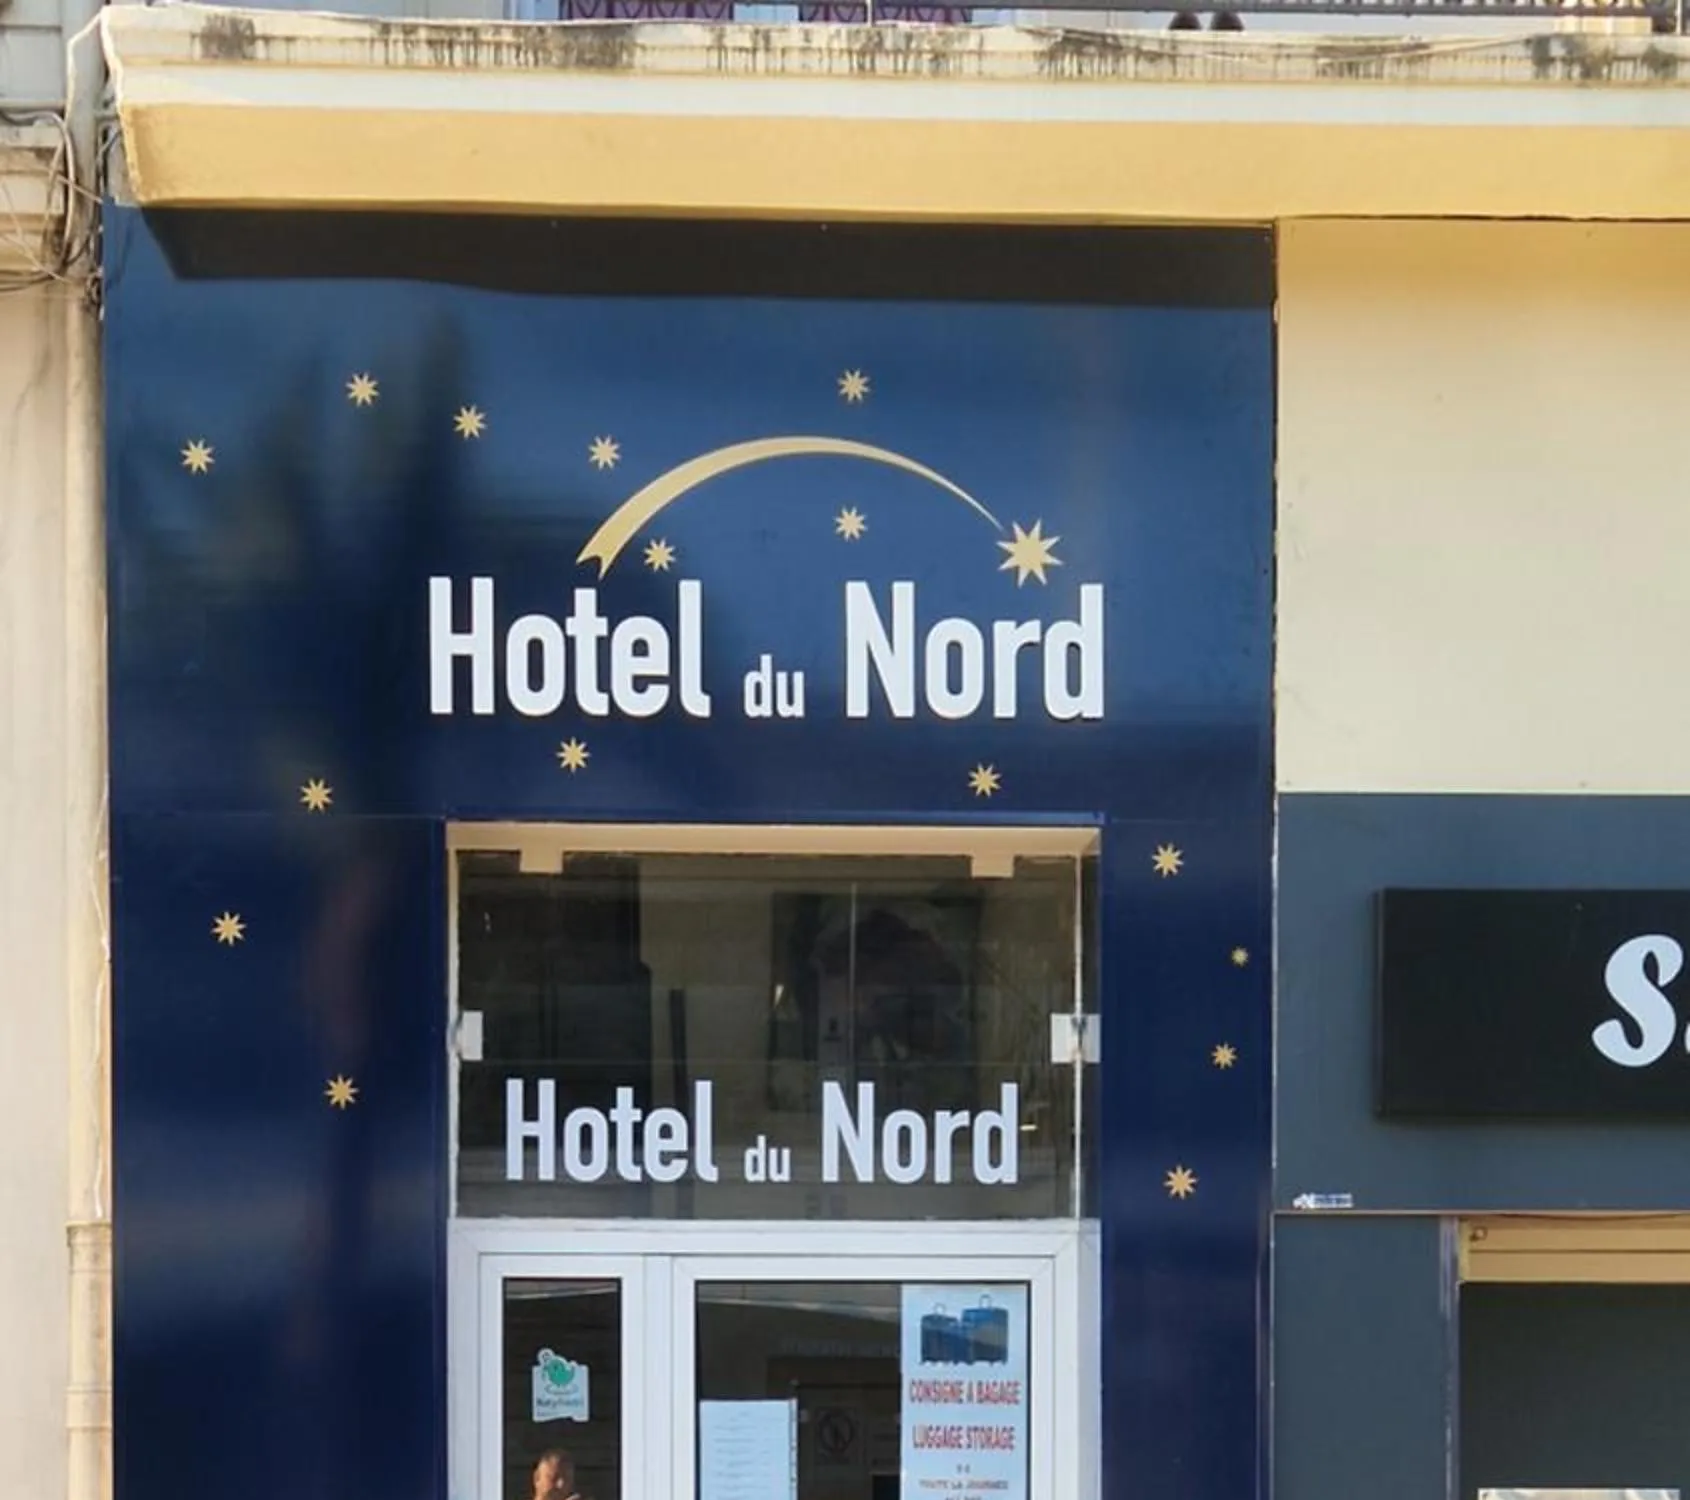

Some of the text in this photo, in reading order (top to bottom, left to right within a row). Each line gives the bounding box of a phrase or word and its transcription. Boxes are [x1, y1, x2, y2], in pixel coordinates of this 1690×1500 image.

[429, 576, 1104, 720] Hotel du Nord
[1592, 934, 1690, 1067] S
[506, 1078, 1019, 1185] Hotel du Nord
[910, 1380, 963, 1404] CONSIGNE
[977, 1381, 1020, 1405] BAGAGE
[912, 1425, 1015, 1450] LUGGAGE STORAGE
